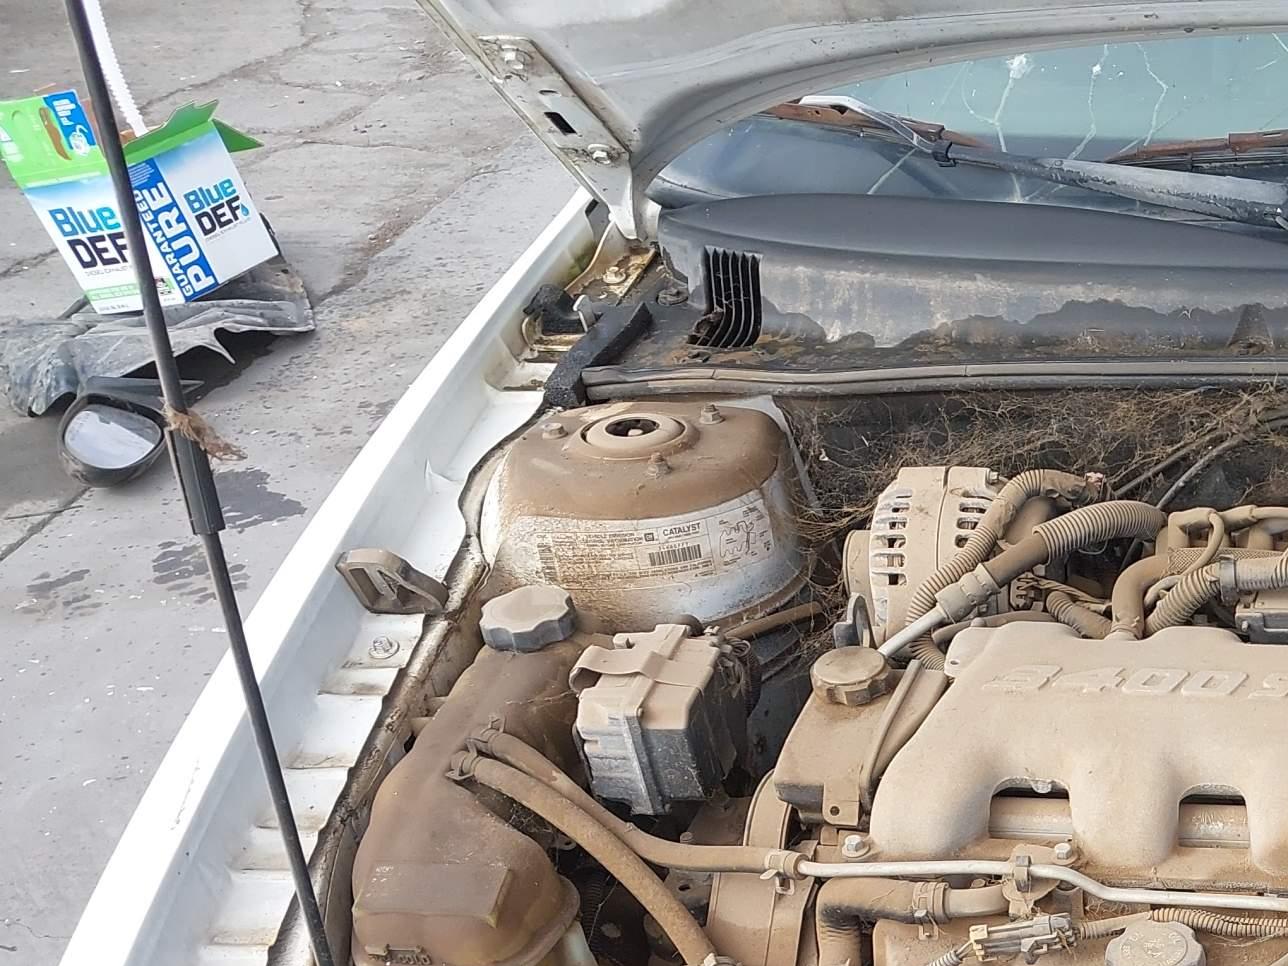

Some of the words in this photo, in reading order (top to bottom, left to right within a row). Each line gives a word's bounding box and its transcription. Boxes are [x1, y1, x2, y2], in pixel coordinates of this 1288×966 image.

[183, 178, 237, 214] Blue
[48, 206, 122, 237] Blue
[195, 195, 240, 236] DEF
[67, 231, 128, 269] DEF
[133, 189, 194, 297] GUARANTEED
[142, 181, 215, 293] PURE
[662, 522, 701, 537] CATALYST
[982, 664, 1249, 695] 3400
